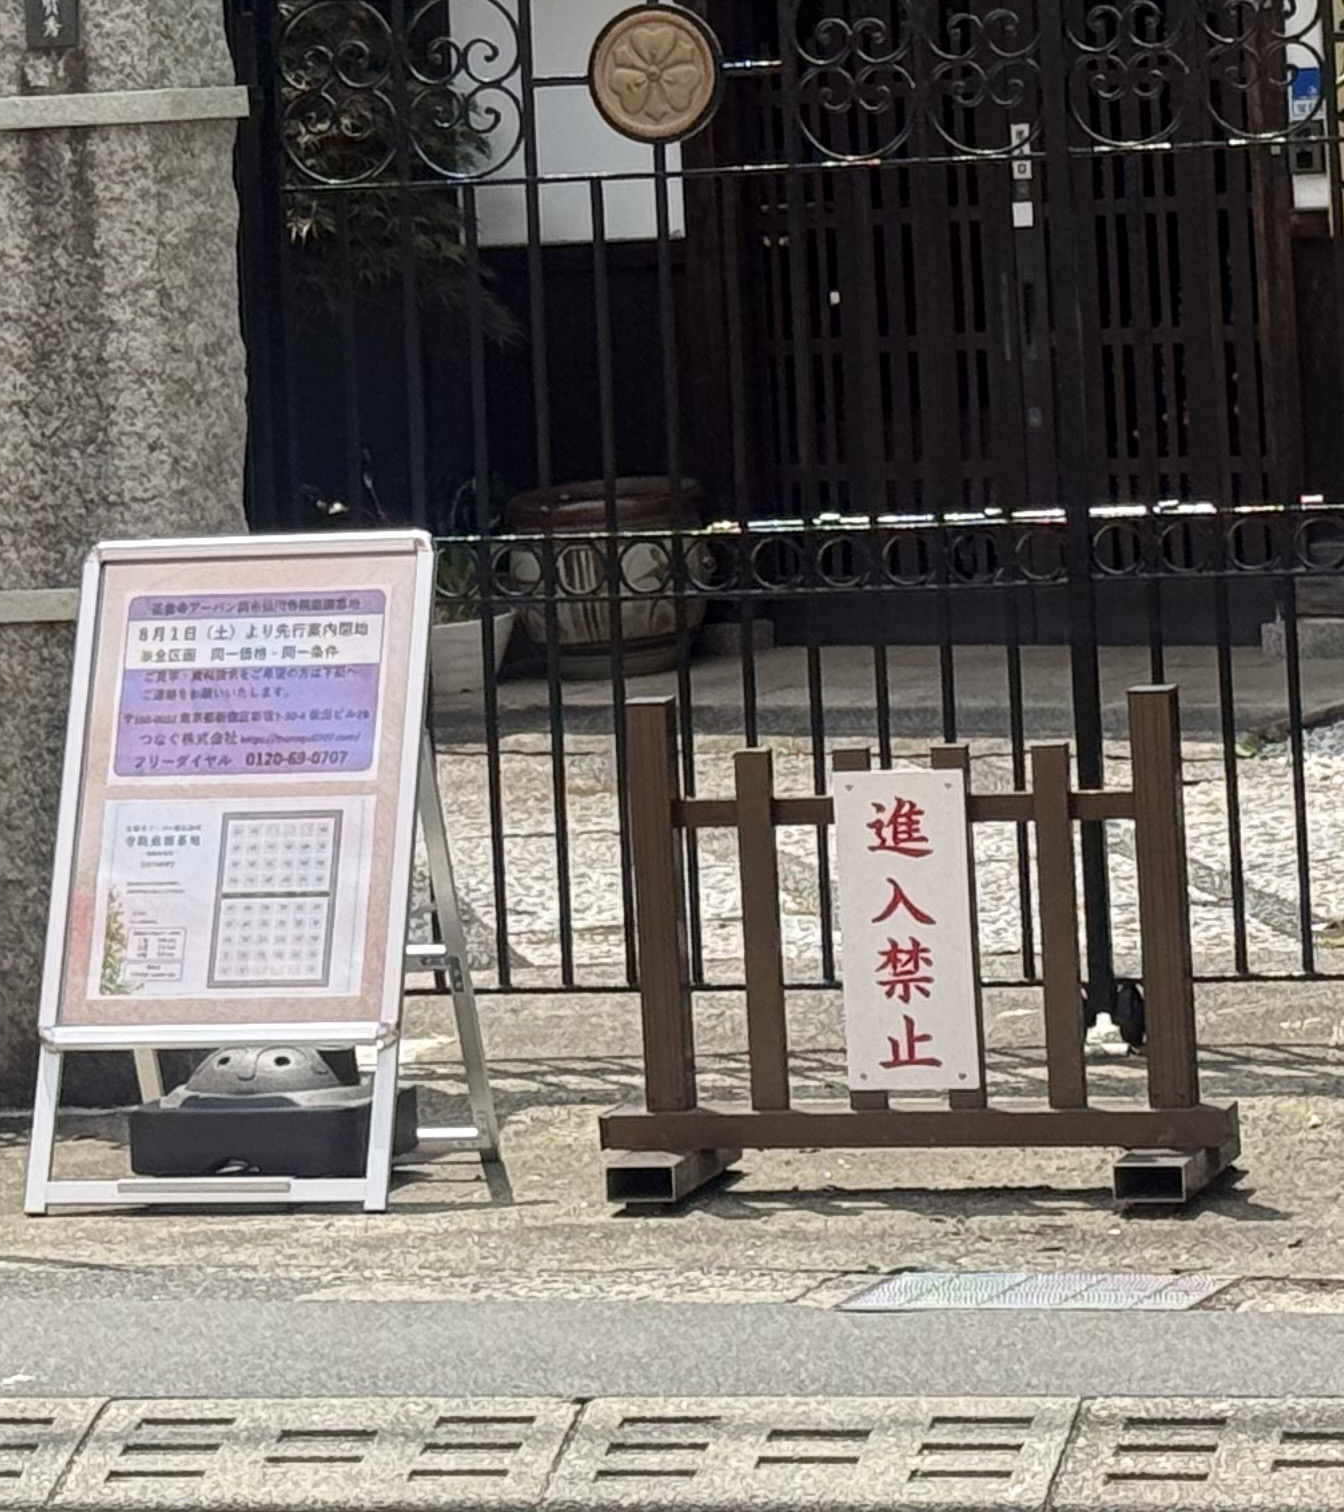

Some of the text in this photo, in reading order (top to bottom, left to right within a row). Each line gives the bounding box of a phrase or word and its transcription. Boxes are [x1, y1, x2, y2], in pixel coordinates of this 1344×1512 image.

[140, 732, 237, 747] つなぐ株式会社
[135, 751, 349, 769] フリーダイヤル 0120-69-0707
[866, 796, 943, 1069] 進入禁止
